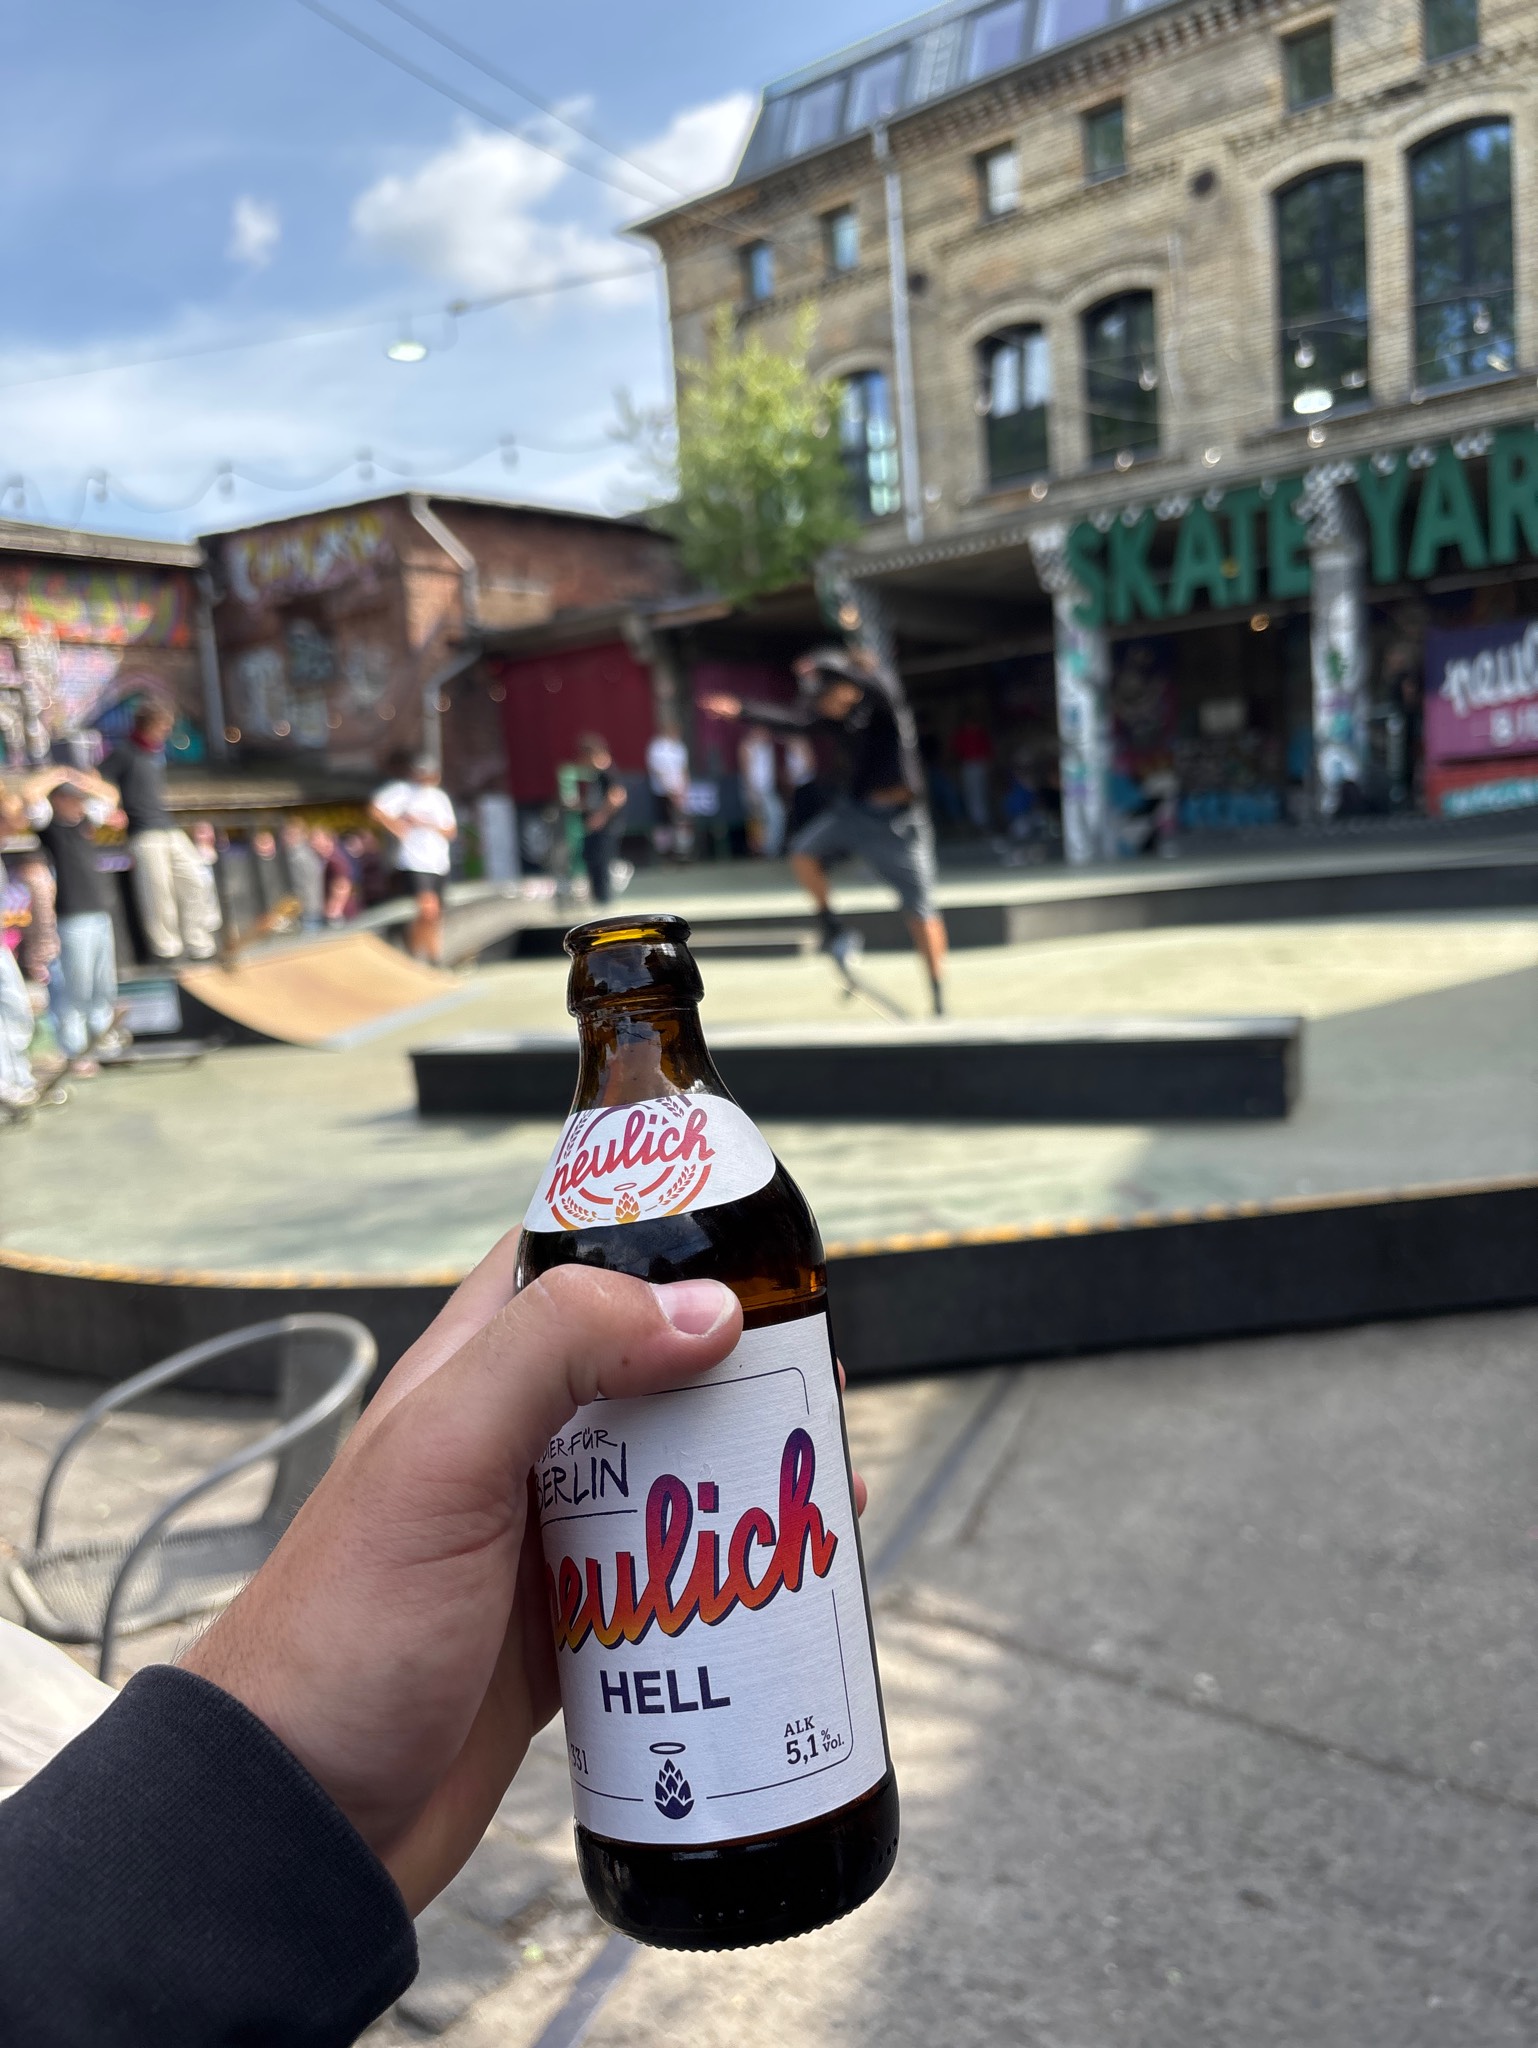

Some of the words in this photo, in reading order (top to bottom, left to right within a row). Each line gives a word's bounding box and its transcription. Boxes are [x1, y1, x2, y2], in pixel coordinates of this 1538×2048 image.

[1066, 474, 1318, 631] SKATE
[545, 1108, 715, 1204] neulich
[567, 1426, 618, 1455] FÜR
[600, 1666, 731, 1714] HELL
[784, 1715, 815, 1738] ALK
[786, 1734, 819, 1765] 5,1
